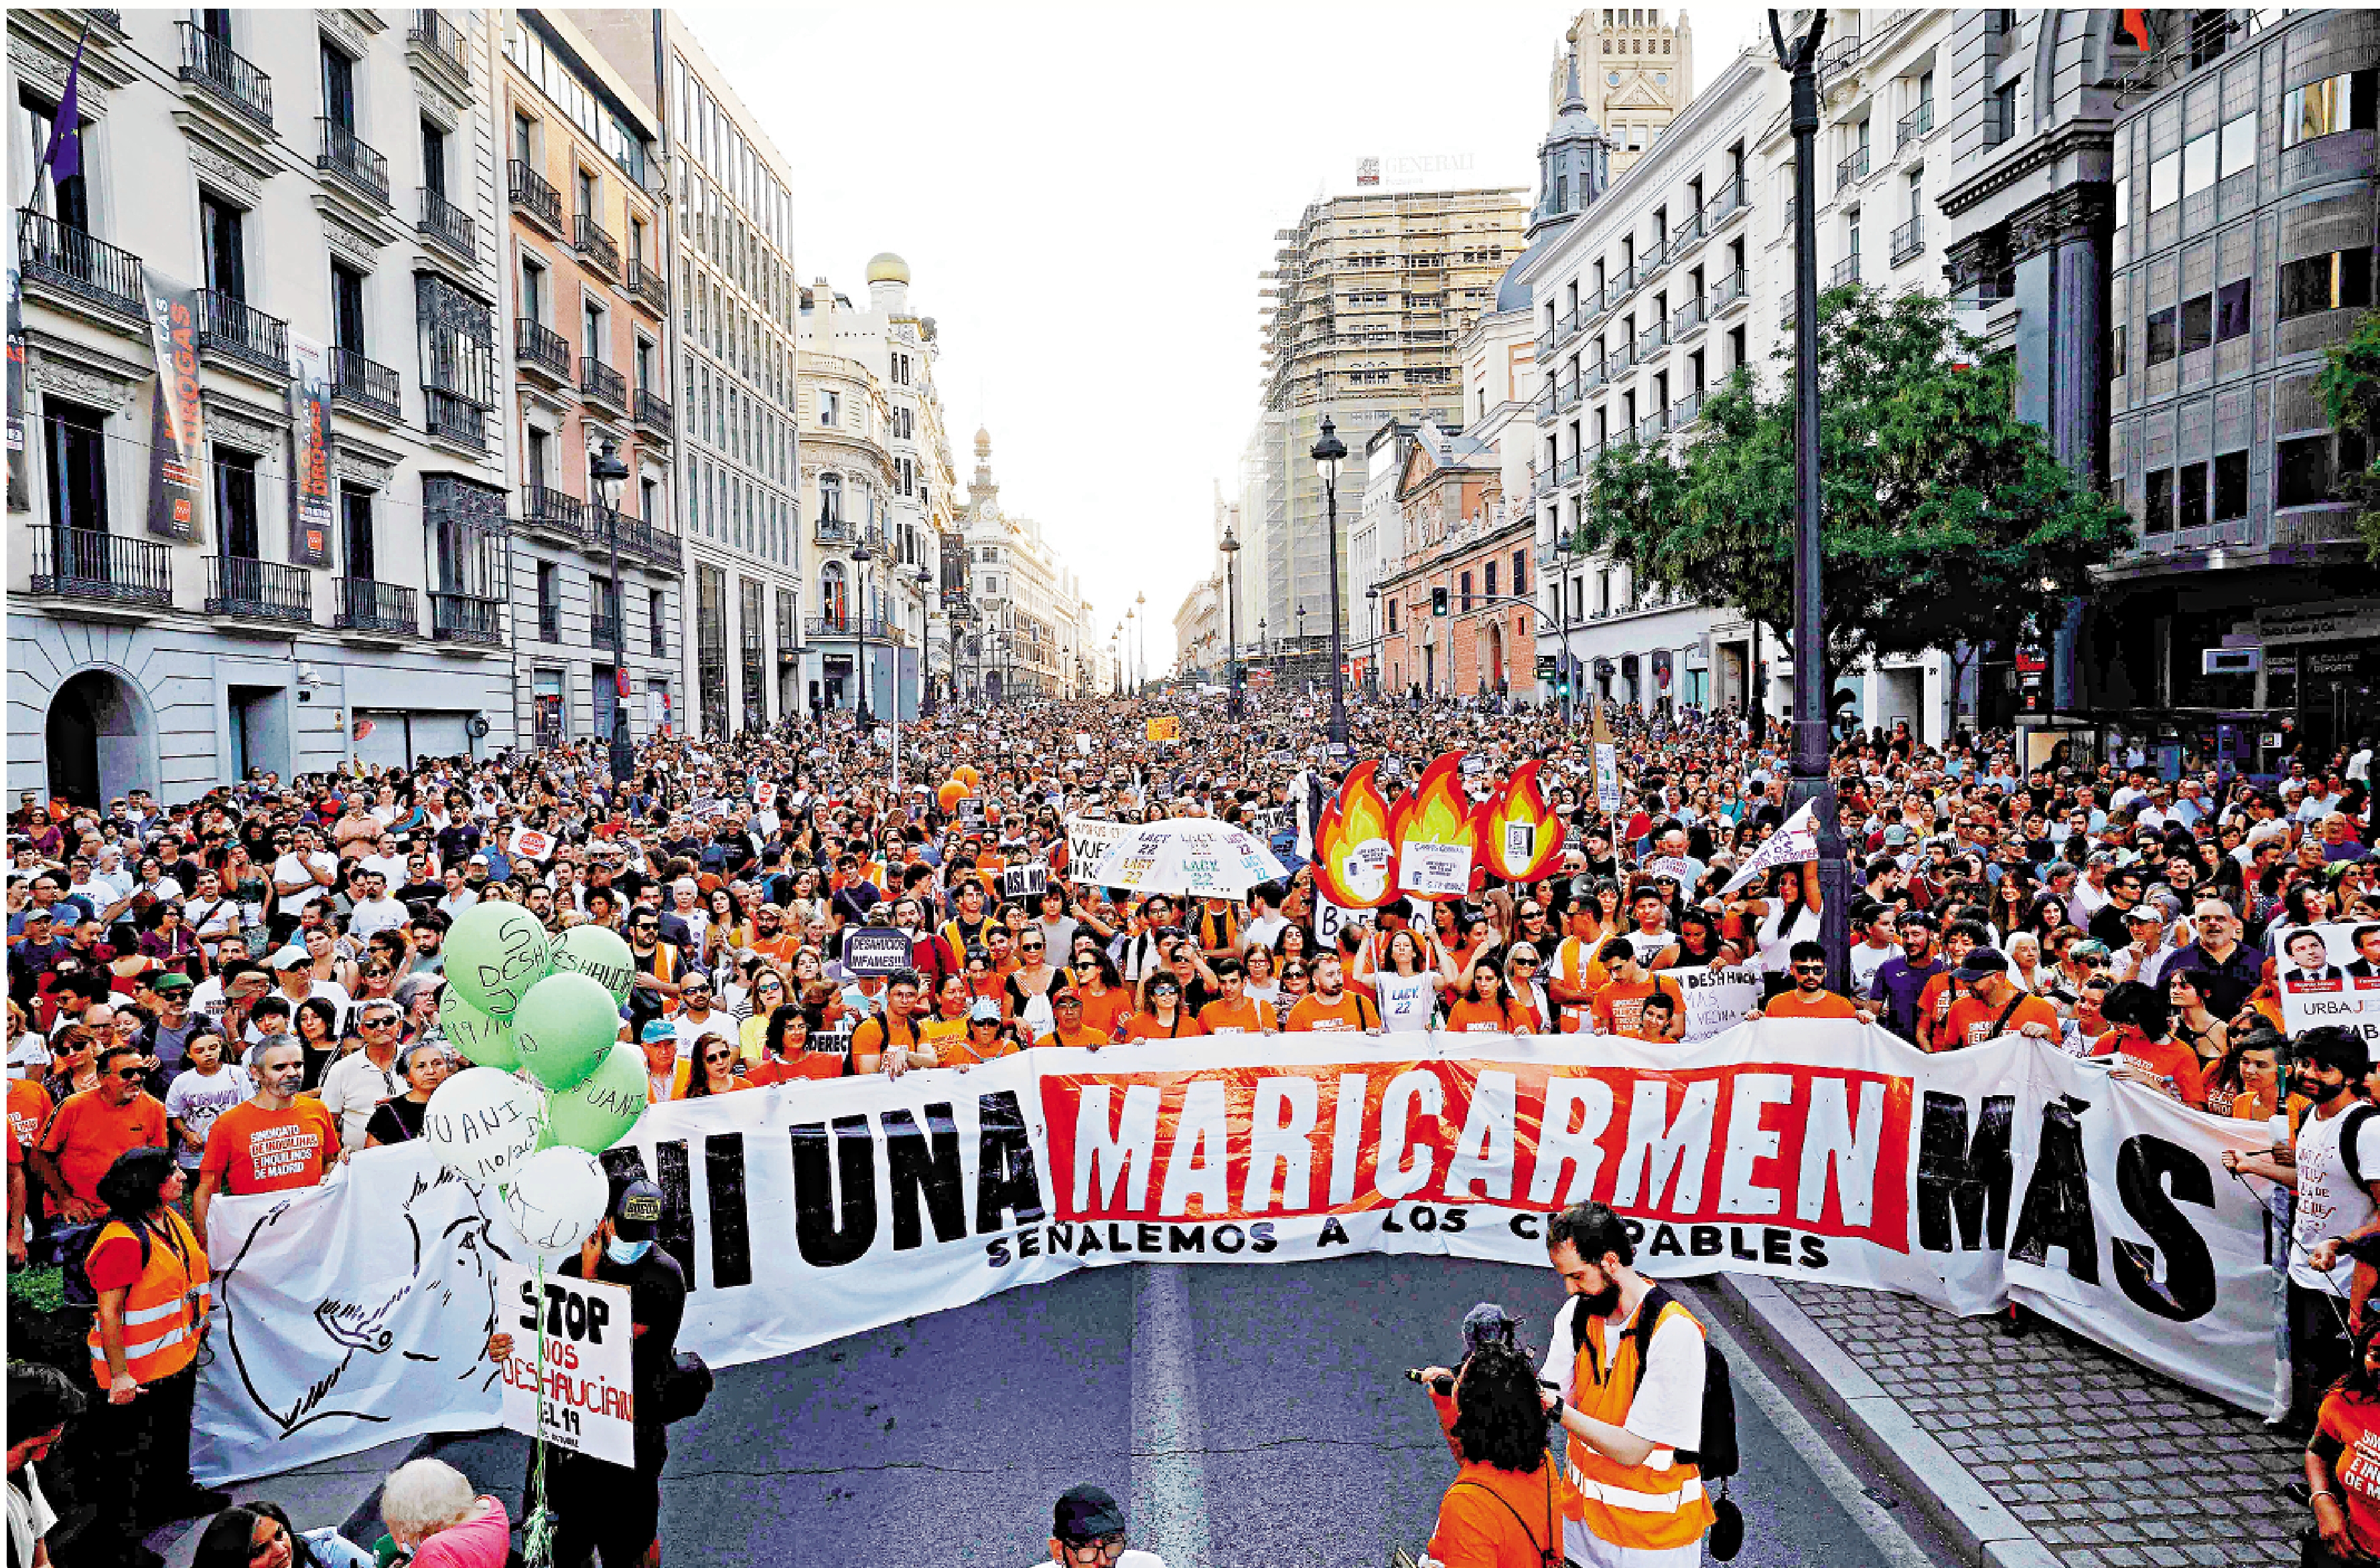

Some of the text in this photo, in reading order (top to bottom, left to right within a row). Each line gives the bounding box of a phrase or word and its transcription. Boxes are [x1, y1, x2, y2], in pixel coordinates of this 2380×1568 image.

[251, 1125, 300, 1143] SINDICATO
[261, 1148, 312, 1167] INQUILINOS
[267, 1161, 304, 1178] MADRID
[789, 1090, 1046, 1268] UNA
[1072, 1072, 1368, 1218] MARI
[1374, 1069, 1887, 1228] CARMEN
[1916, 1088, 2217, 1324] MÁS
[985, 1219, 1277, 1269] SEÑALEMOS
[1316, 1216, 1350, 1249] A
[1509, 1213, 1830, 1270] CPABLES
[519, 1279, 610, 1345] STOP
[561, 1407, 581, 1436] 19
